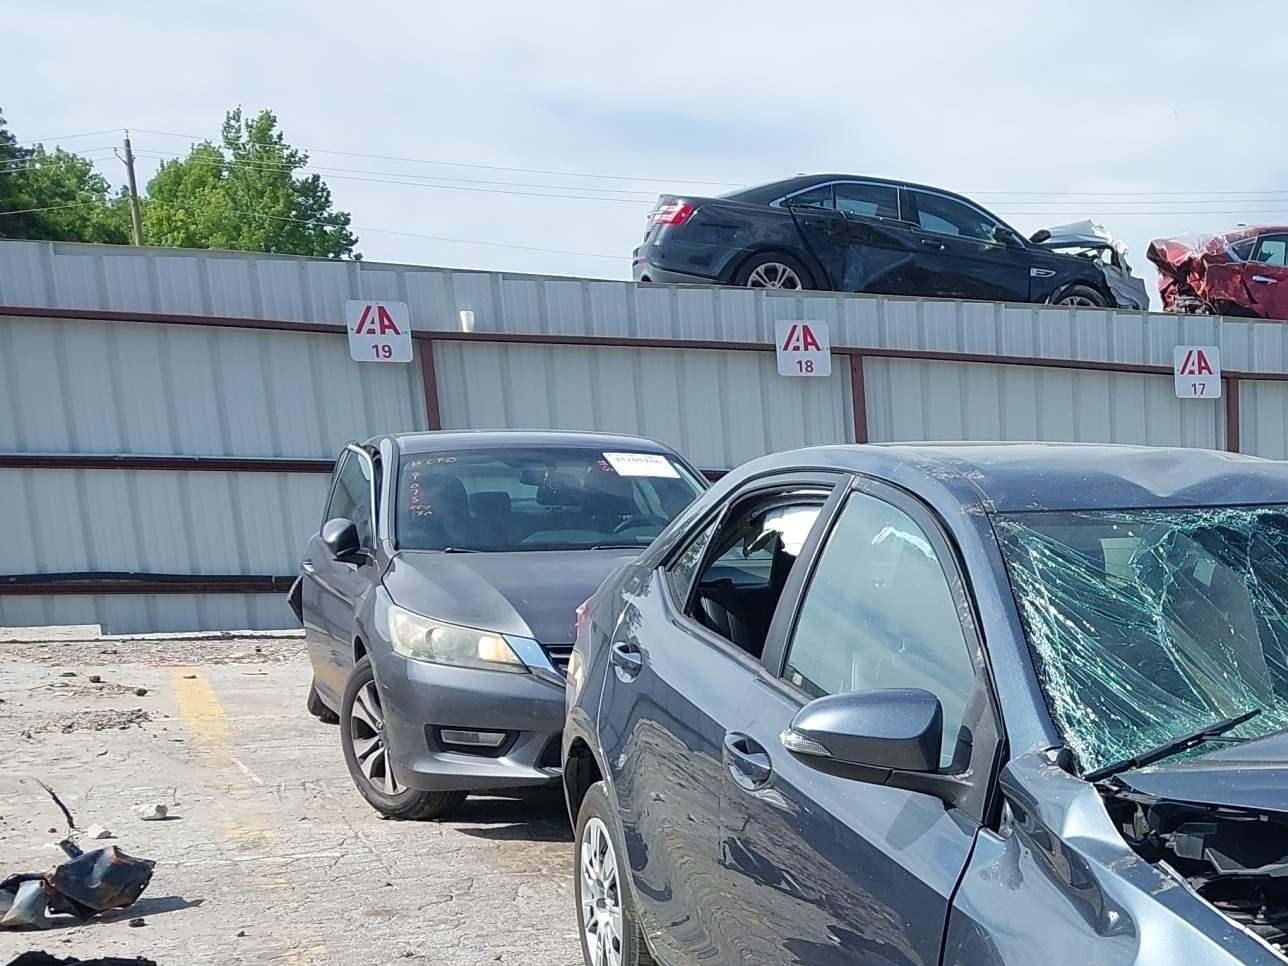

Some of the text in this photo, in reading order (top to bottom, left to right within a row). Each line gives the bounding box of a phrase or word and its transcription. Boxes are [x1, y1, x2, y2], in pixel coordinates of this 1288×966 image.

[371, 344, 393, 359] 19
[795, 359, 815, 373] 18
[1191, 382, 1206, 395] 17
